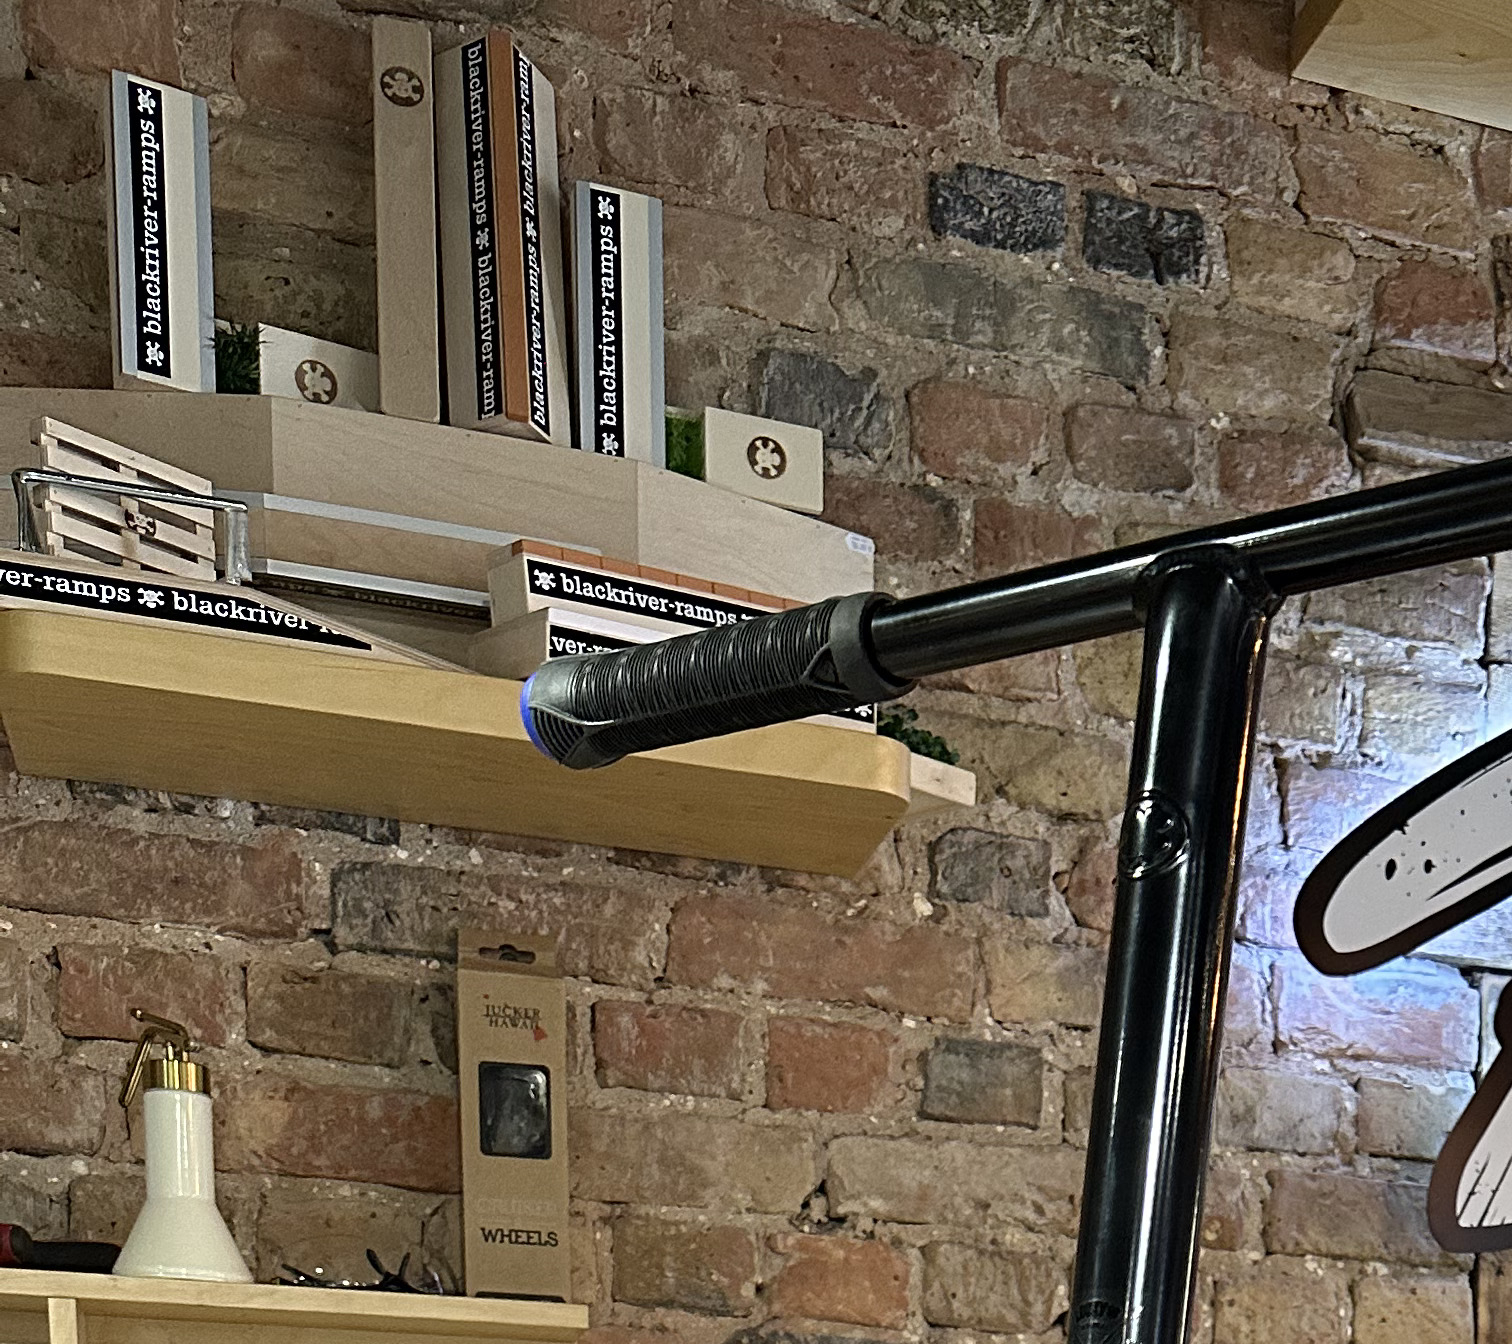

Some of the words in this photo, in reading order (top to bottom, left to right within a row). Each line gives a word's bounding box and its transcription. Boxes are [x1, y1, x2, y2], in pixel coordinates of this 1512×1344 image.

[467, 42, 487, 226] blackriver-ramps
[141, 118, 165, 336] blackriver-ramps
[527, 244, 547, 426] blackriver-ramps
[599, 224, 618, 427] blackriver-ramps
[560, 572, 737, 628] blackriver-ramps
[480, 1227, 559, 1248] WHEELS
